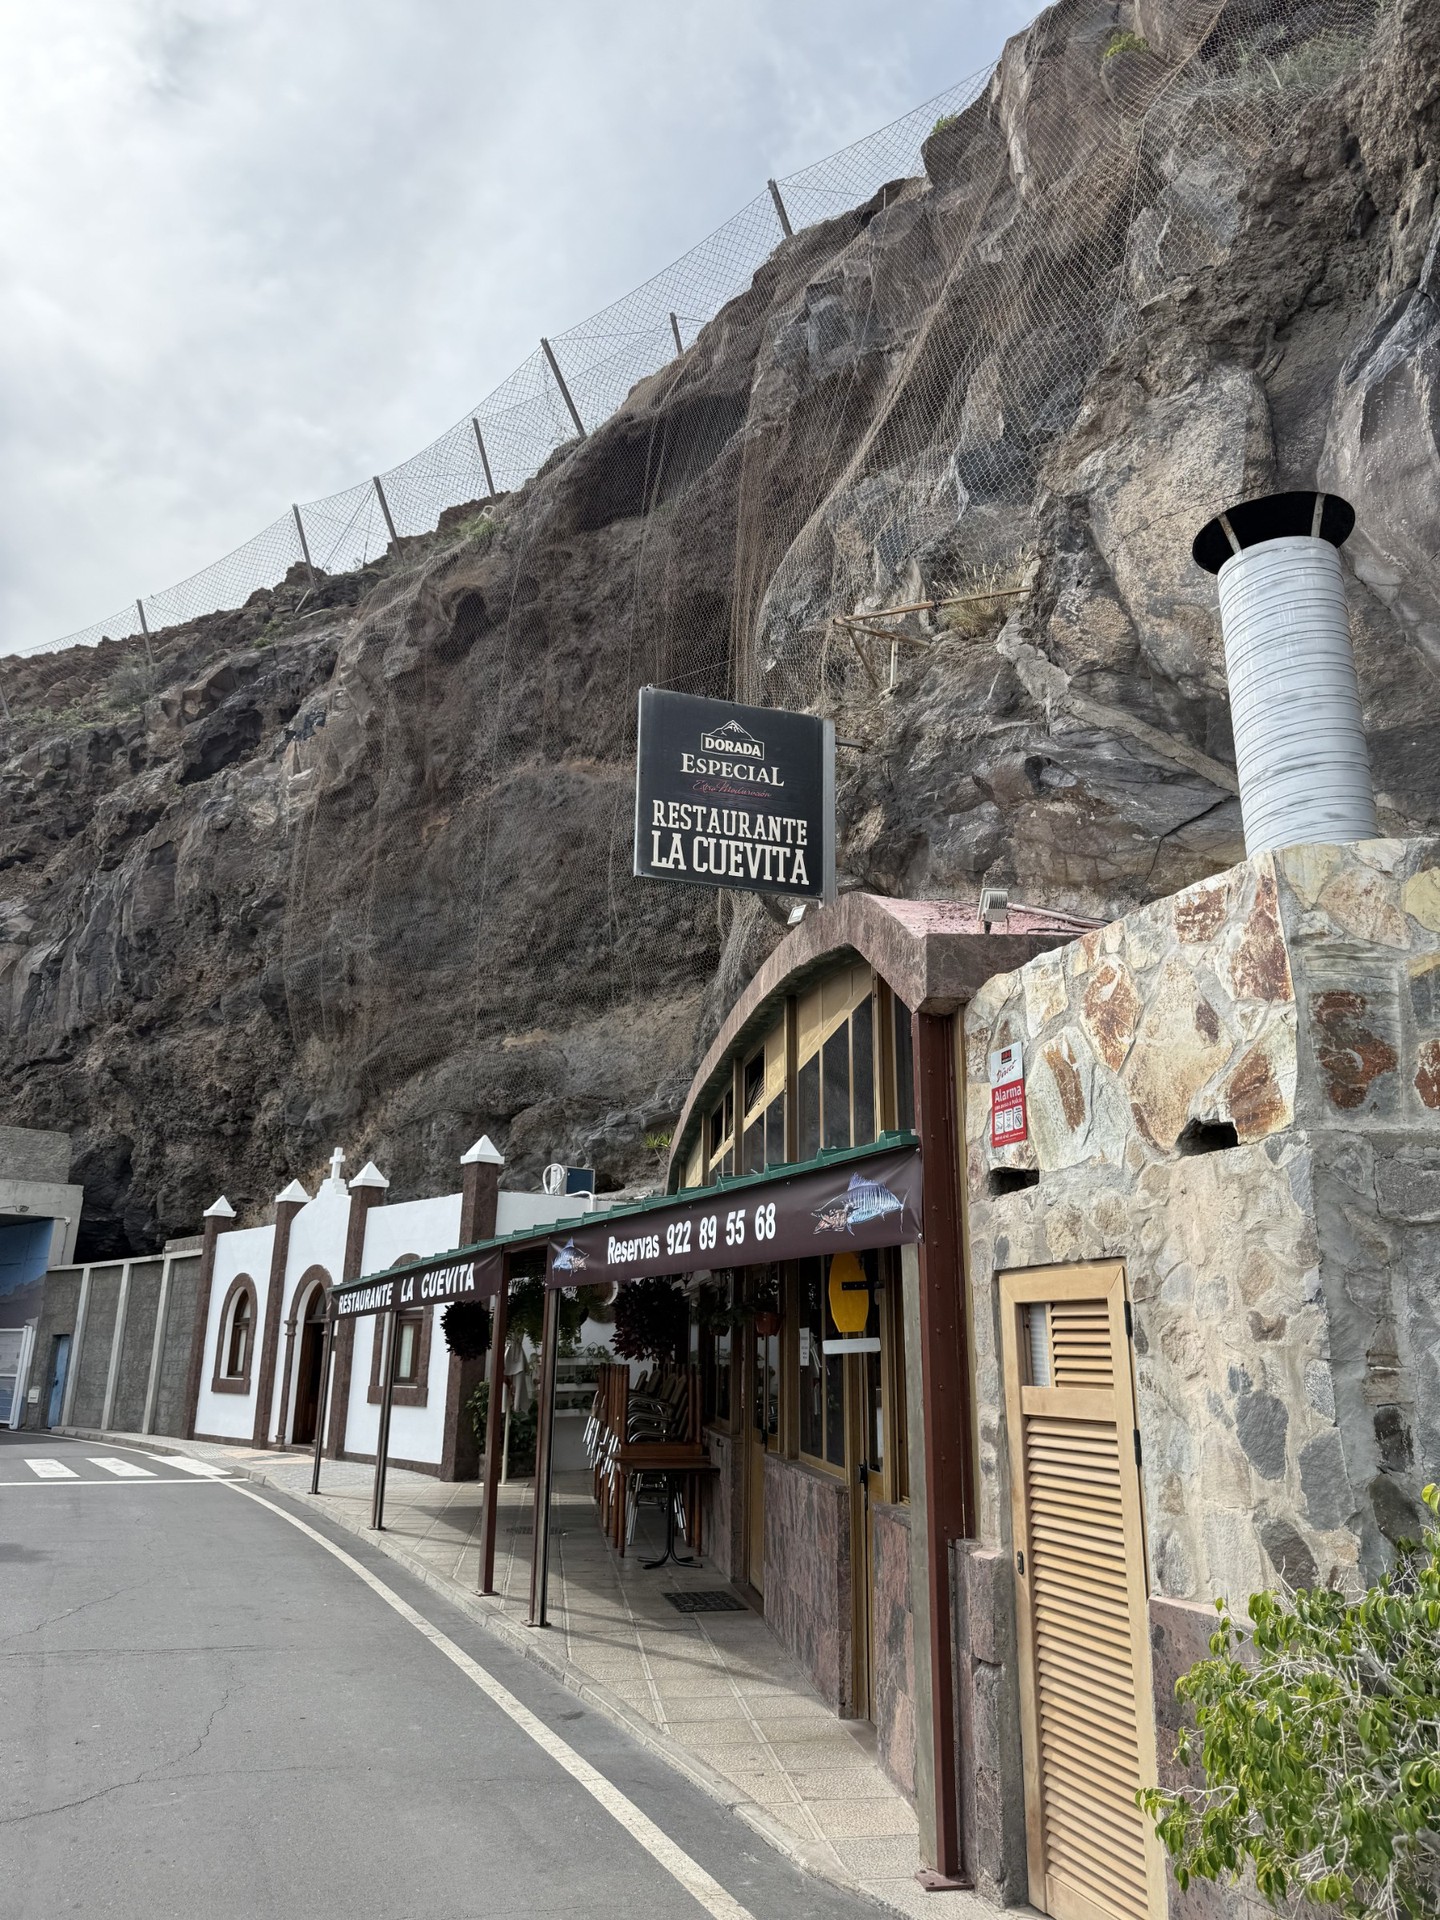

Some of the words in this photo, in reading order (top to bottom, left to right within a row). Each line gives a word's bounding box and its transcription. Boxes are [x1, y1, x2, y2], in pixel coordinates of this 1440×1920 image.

[680, 753, 785, 787] ESPECIAL
[705, 737, 761, 757] DORADA
[652, 800, 808, 846] RESTAURANTE
[651, 830, 687, 870] LA
[692, 836, 809, 886] CUEVITA
[994, 1084, 1022, 1104] Alarma
[607, 1234, 659, 1264] Reservas
[666, 1220, 692, 1255] 922
[699, 1216, 717, 1249] 89
[726, 1209, 746, 1245] 55
[755, 1202, 777, 1240] 68
[338, 1282, 394, 1315] RESTAURANTE
[400, 1277, 415, 1303] LA
[421, 1262, 475, 1299] CUEVITA
